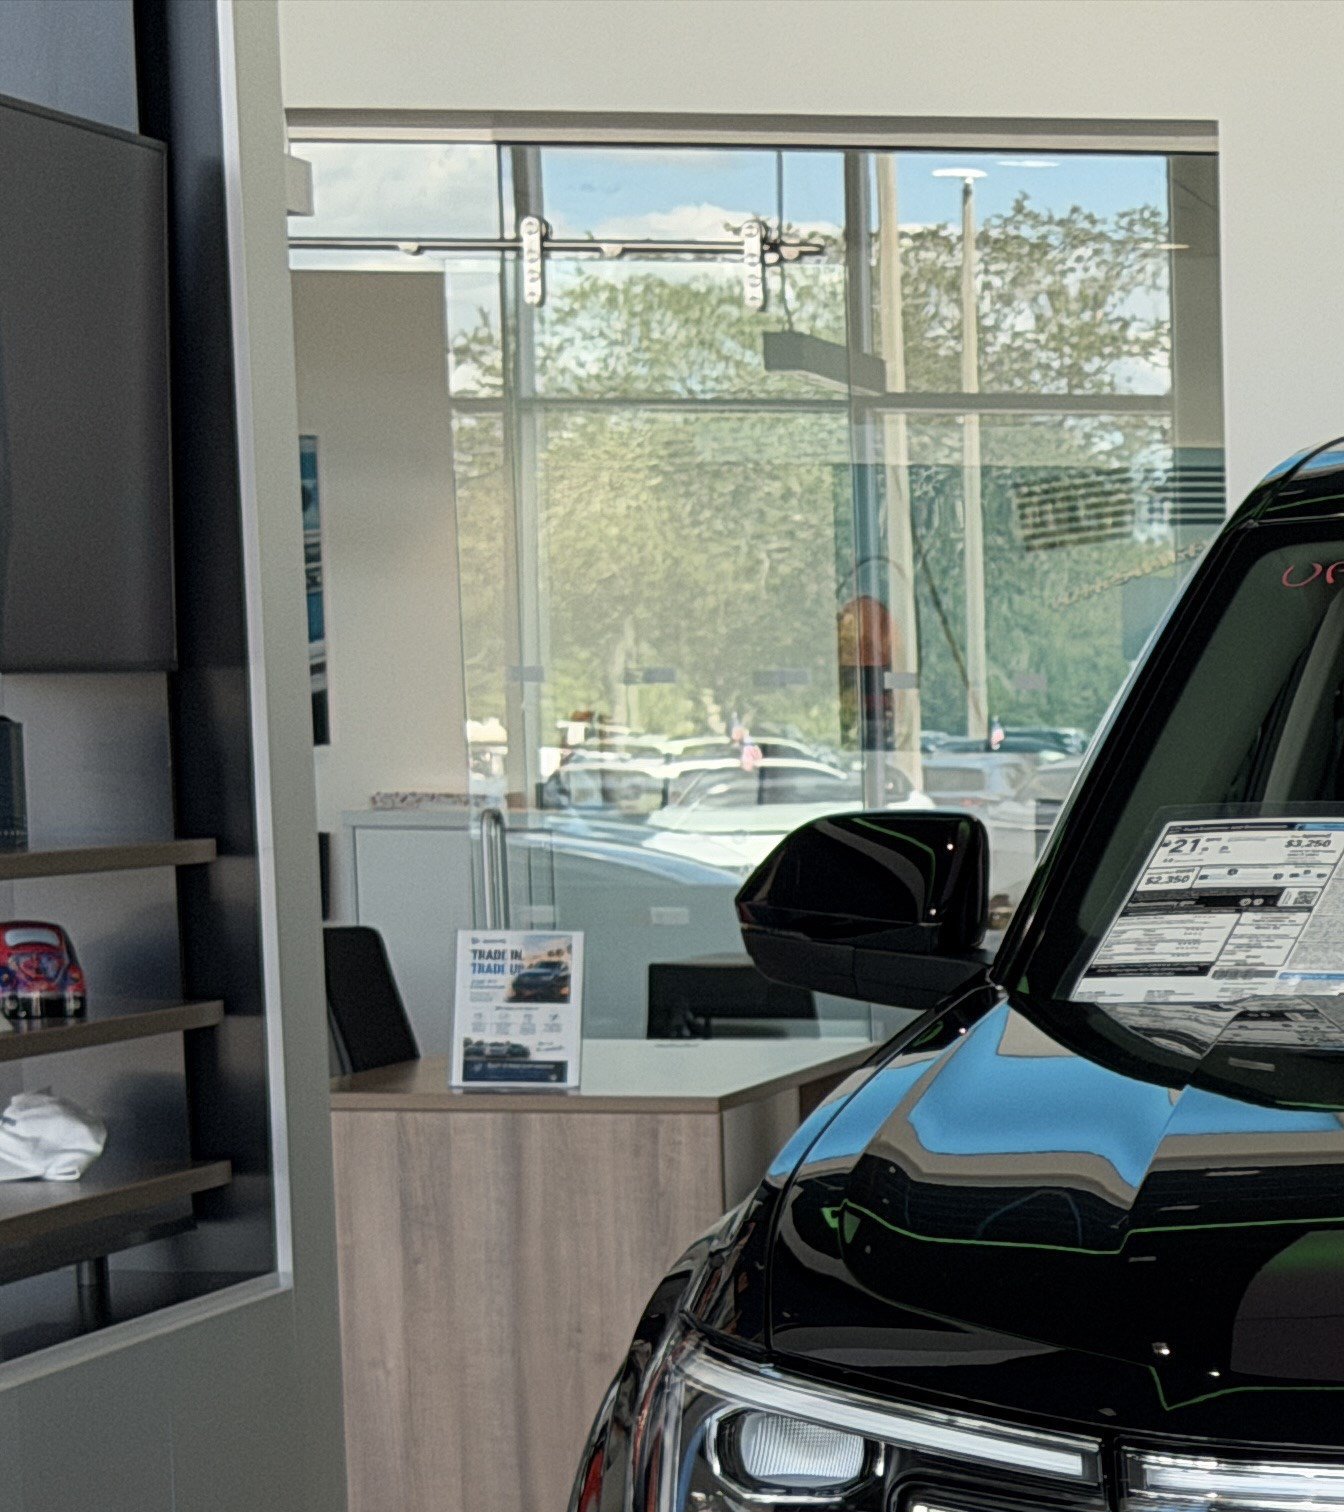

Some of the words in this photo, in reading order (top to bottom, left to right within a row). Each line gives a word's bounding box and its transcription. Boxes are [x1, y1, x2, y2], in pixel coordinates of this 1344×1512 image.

[1168, 838, 1202, 854] 21
[470, 948, 506, 960] TRADE
[510, 948, 523, 960] IN
[470, 962, 506, 975] TRADE
